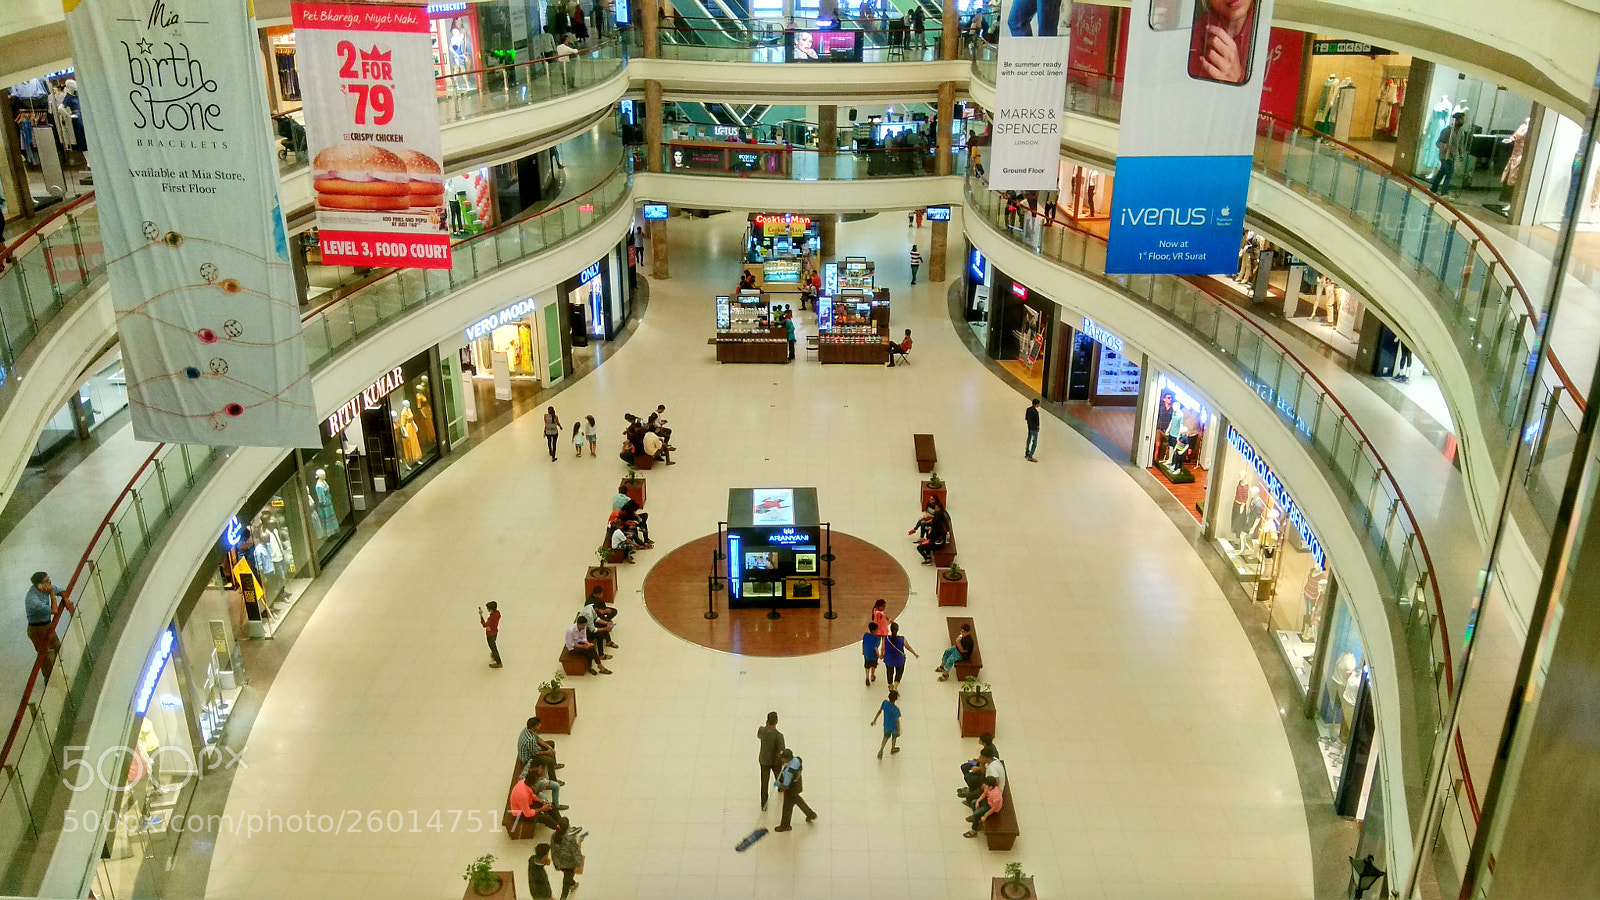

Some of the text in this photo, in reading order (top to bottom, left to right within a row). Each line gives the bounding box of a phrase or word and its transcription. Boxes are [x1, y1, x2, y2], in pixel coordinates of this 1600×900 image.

[147, 0, 179, 30] Mia
[303, 10, 318, 21] Pet
[320, 11, 361, 28] Bharega,
[394, 15, 418, 25] Nahi.
[120, 41, 217, 92] birth
[336, 40, 393, 80] 2 FOR
[1042, 61, 1062, 70] ready
[129, 86, 224, 131] Stone
[1000, 108, 1056, 120] MARKS &
[714, 126, 738, 136] LOTUS
[996, 123, 1058, 135] SPENCER
[136, 139, 229, 149] BRACELETS
[350, 132, 404, 143] CRISPY CHICKEN
[129, 167, 246, 182] Available at Mia Store,
[1002, 167, 1027, 175] Ground
[161, 183, 217, 194] First Floor
[756, 214, 811, 223] Cookie Man
[323, 240, 448, 259] LEVEL 3, FOOD COURT
[1159, 240, 1188, 248] Now at
[1148, 252, 1171, 261] Floor,
[1172, 252, 1183, 260] VR
[1185, 252, 1206, 260] Surat
[580, 261, 600, 283] ONLY
[465, 297, 536, 341] VERO MODA
[1082, 316, 1124, 353] PARCOS
[326, 366, 404, 438] RITU KUMAR
[1226, 425, 1255, 464] UNITED
[1252, 455, 1284, 500] COLORS
[1280, 489, 1293, 513] OF
